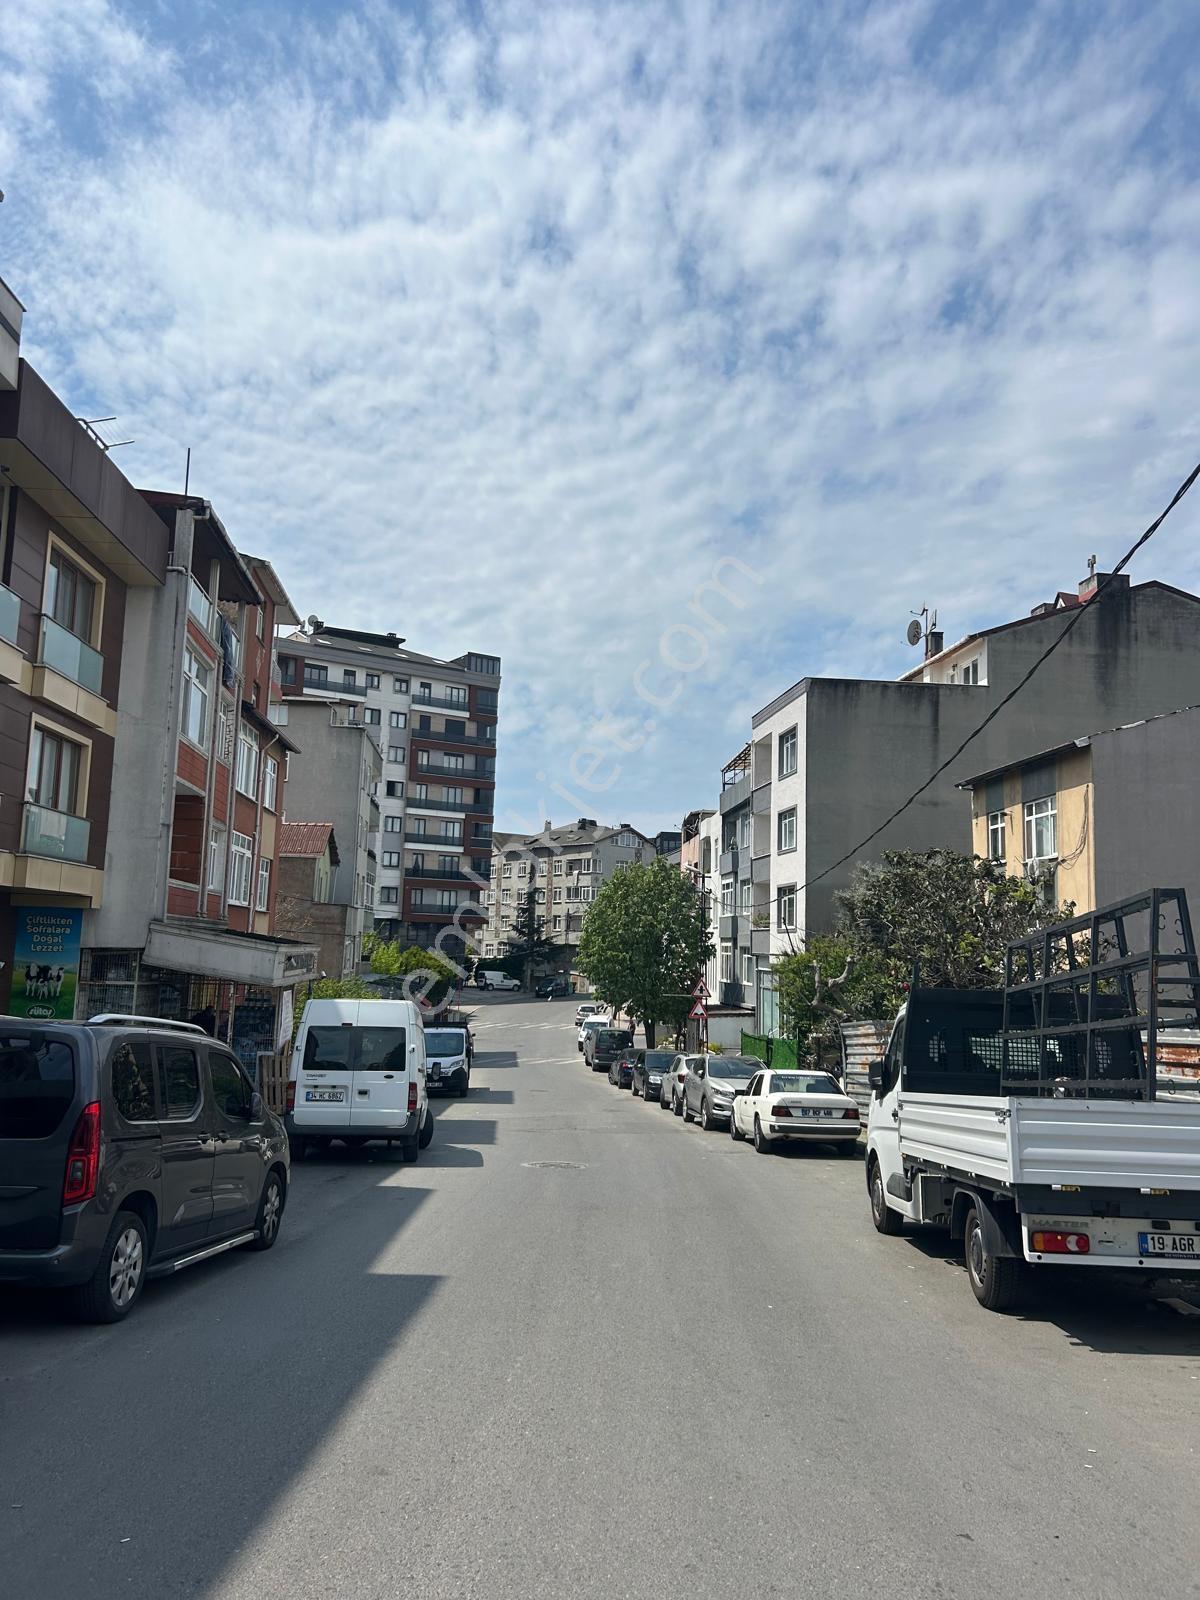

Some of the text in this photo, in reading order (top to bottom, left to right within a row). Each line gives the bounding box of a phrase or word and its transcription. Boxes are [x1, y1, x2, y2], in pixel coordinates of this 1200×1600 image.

[26, 915, 73, 926] Çiftlikten
[26, 925, 71, 934] Sofralara
[33, 934, 62, 944] Doğal
[31, 944, 64, 952] Lezzet
[1031, 1218, 1089, 1228] MASTER
[1150, 1235, 1165, 1251] 19
[1171, 1236, 1195, 1252] AGR
